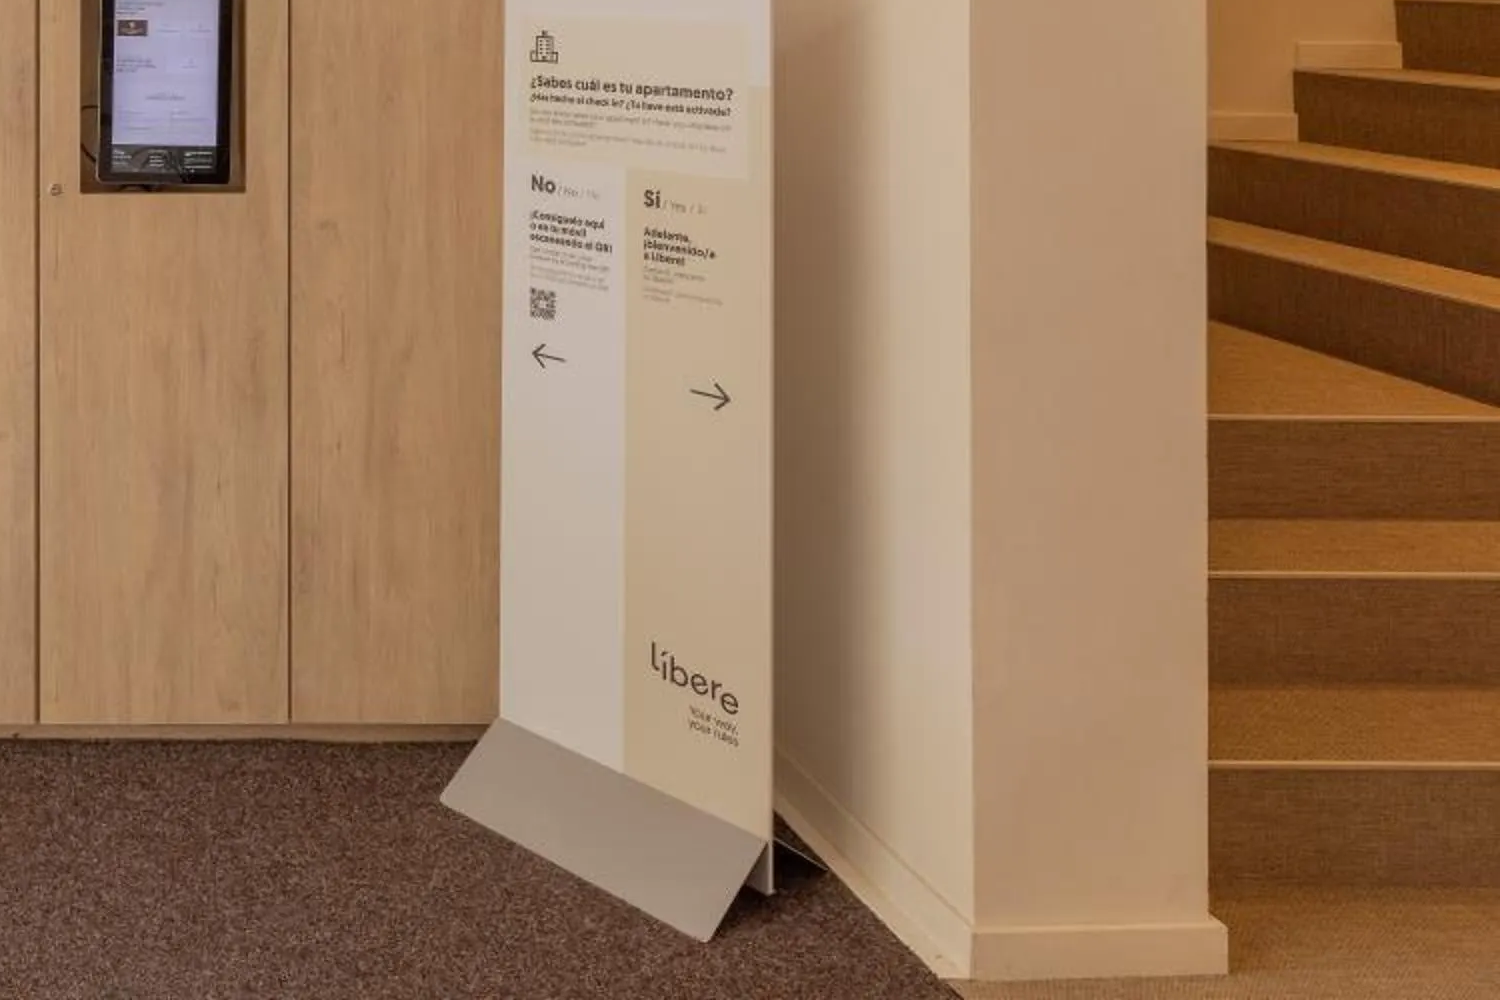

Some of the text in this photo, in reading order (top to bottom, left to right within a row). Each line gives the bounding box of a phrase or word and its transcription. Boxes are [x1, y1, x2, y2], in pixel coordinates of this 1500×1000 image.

[531, 75, 734, 101] ¿Sabes cuál es tu apartamento?
[531, 173, 556, 194] No
